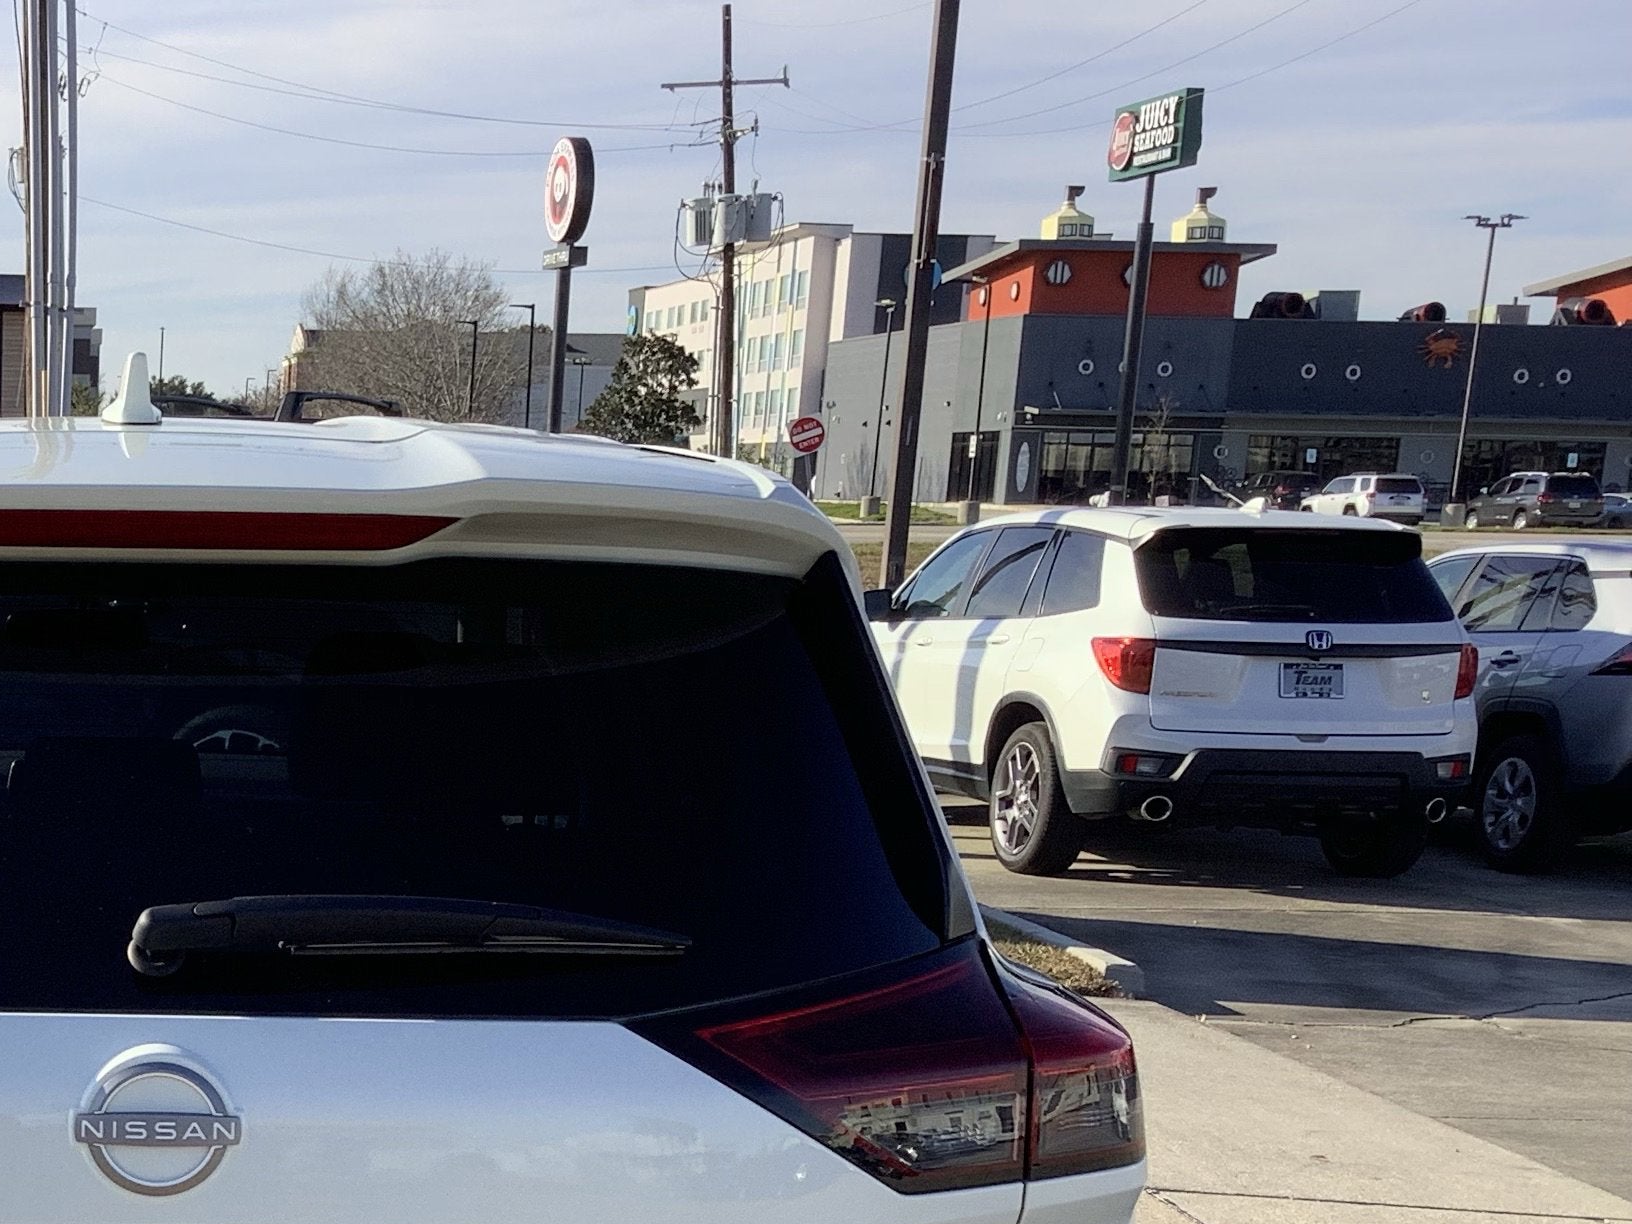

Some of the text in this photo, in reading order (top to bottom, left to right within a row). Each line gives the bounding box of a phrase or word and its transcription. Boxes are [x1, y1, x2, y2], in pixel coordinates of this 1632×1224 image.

[1135, 96, 1179, 133] JUICY
[1133, 125, 1175, 153] SEAFOOD
[80, 1119, 236, 1141] NISSAN
